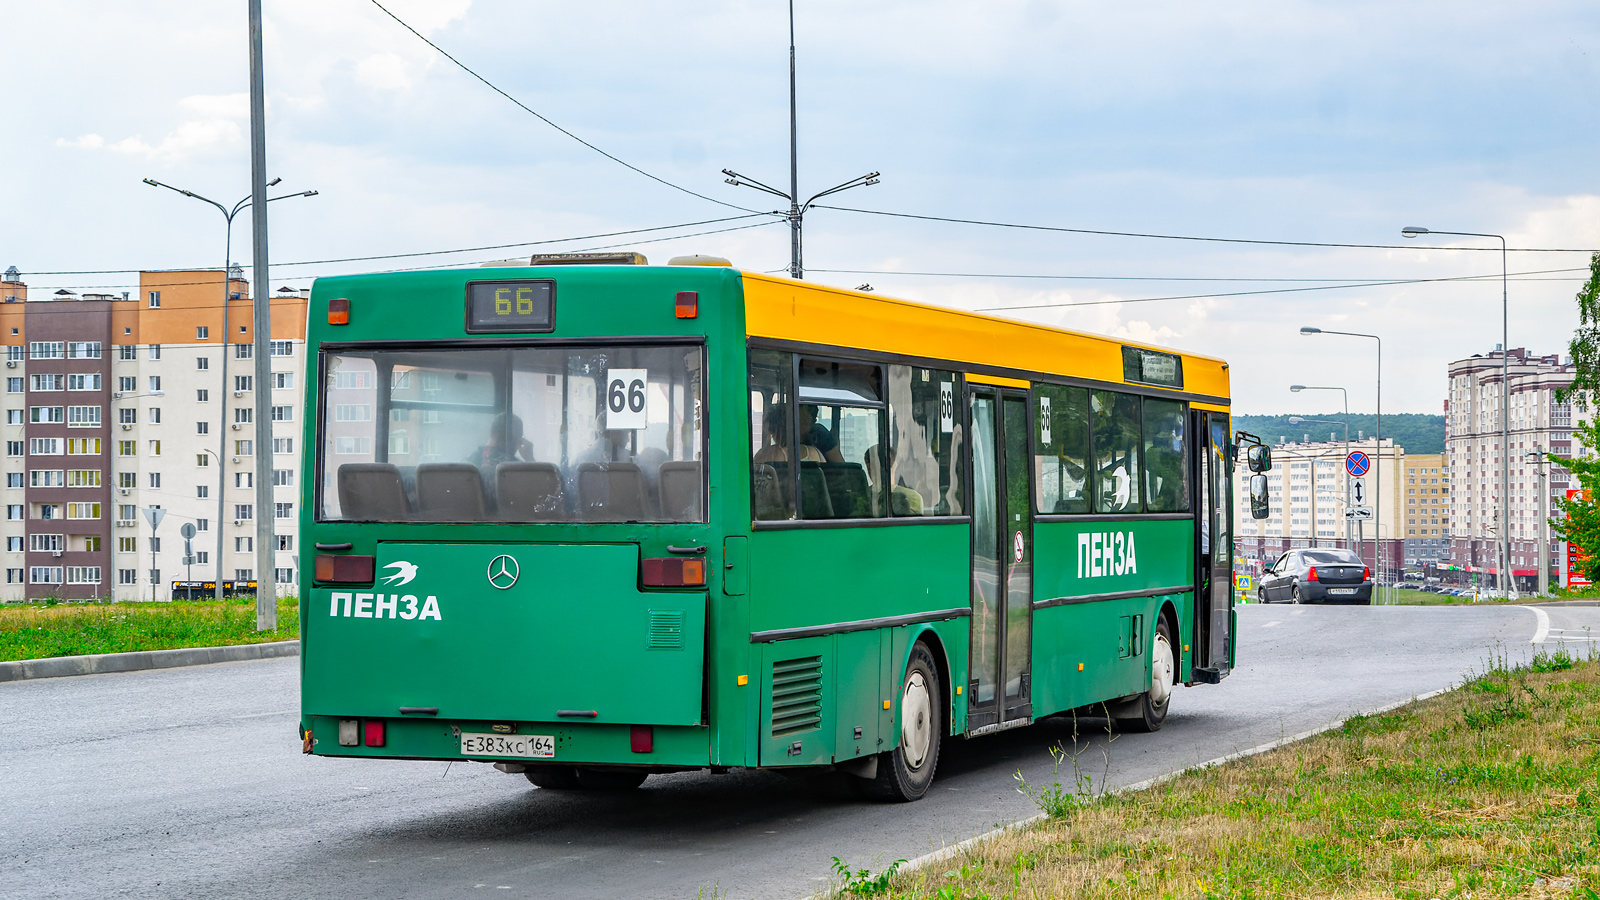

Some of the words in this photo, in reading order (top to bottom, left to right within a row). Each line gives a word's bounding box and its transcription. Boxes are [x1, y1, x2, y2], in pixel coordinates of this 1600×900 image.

[495, 287, 533, 315] 66
[608, 378, 645, 414] 66
[941, 390, 953, 419] 66
[1041, 404, 1050, 431] 66
[1077, 530, 1137, 579] ПЕНЗА
[330, 592, 442, 620] ПЕНЗА
[466, 737, 524, 753] Е383КС
[528, 738, 551, 750] 164
